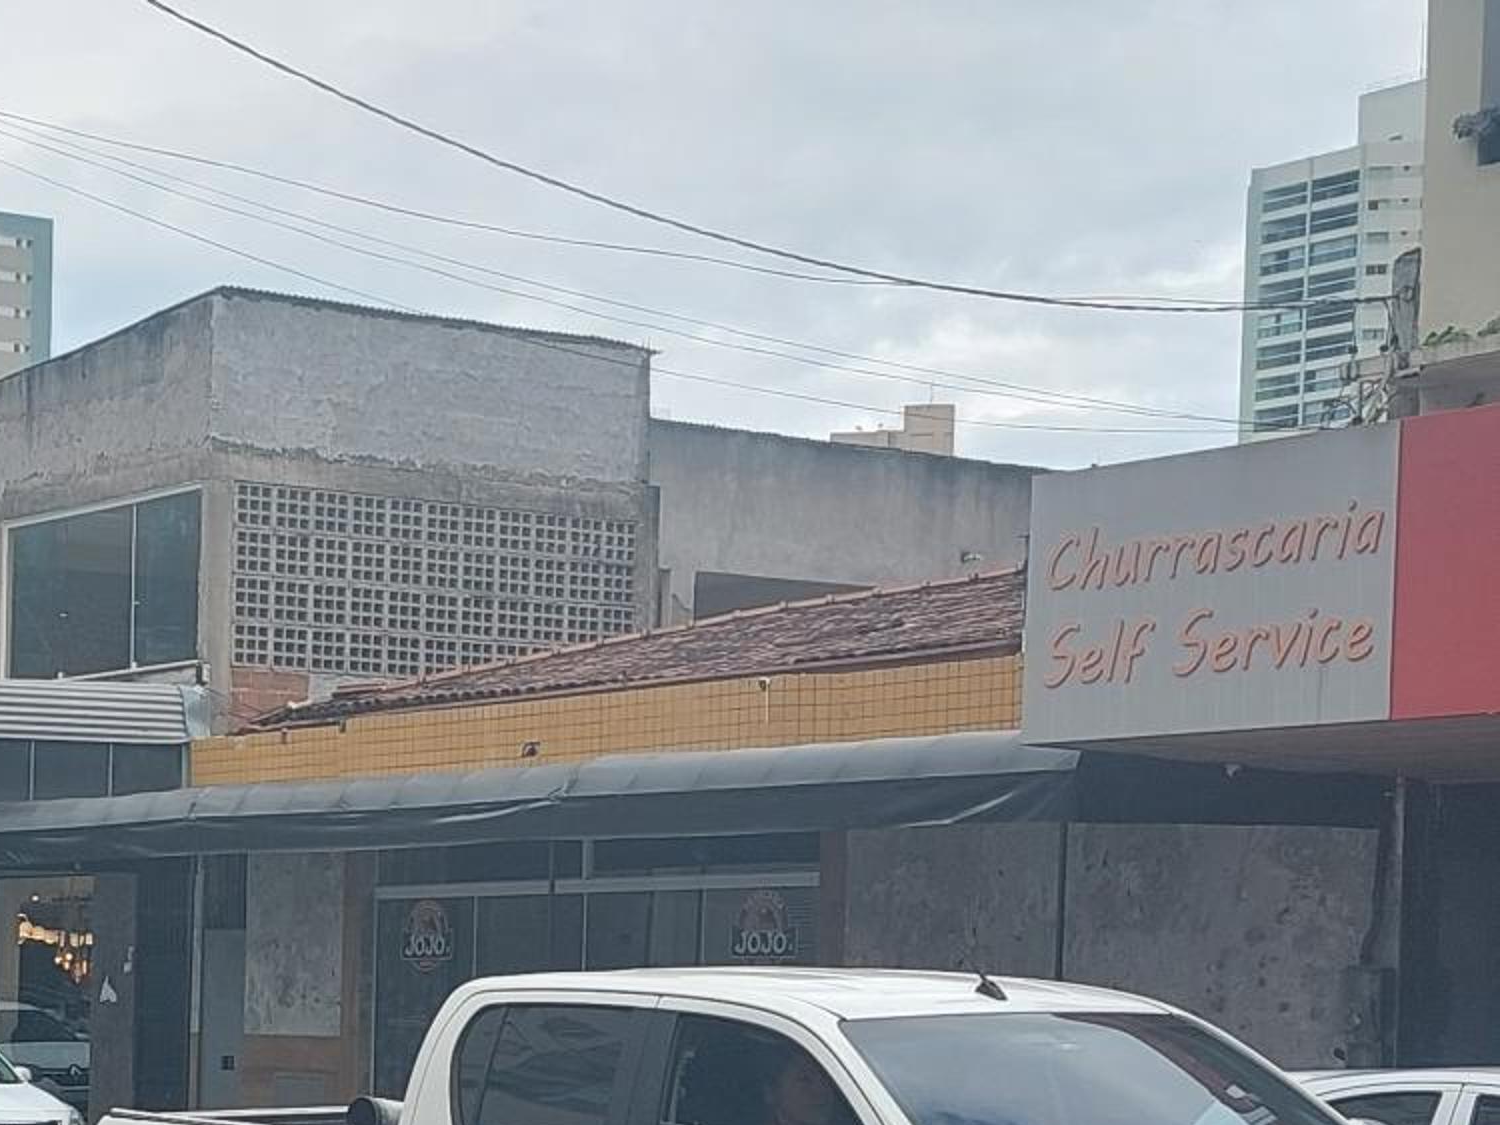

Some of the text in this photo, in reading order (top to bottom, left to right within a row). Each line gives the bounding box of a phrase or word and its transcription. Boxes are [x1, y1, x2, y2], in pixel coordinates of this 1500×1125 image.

[1048, 498, 1386, 592] Churrascaria
[1044, 606, 1375, 690] Self Service
